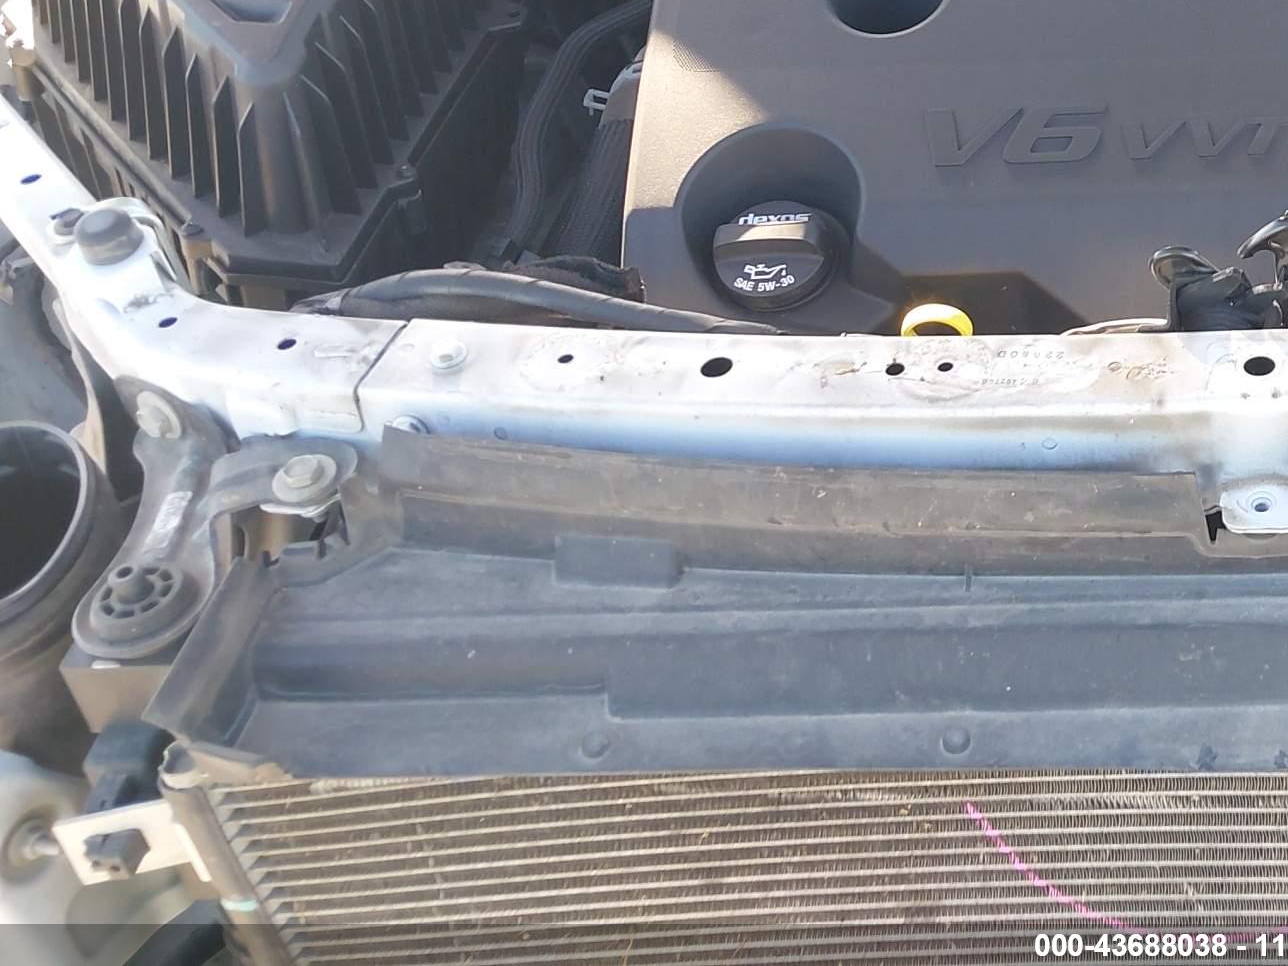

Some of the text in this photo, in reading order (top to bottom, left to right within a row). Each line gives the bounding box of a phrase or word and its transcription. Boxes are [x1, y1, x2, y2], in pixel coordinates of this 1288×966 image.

[924, 105, 1108, 167] V6
[738, 213, 812, 225] dexos
[734, 275, 795, 292] SAE 5W-30
